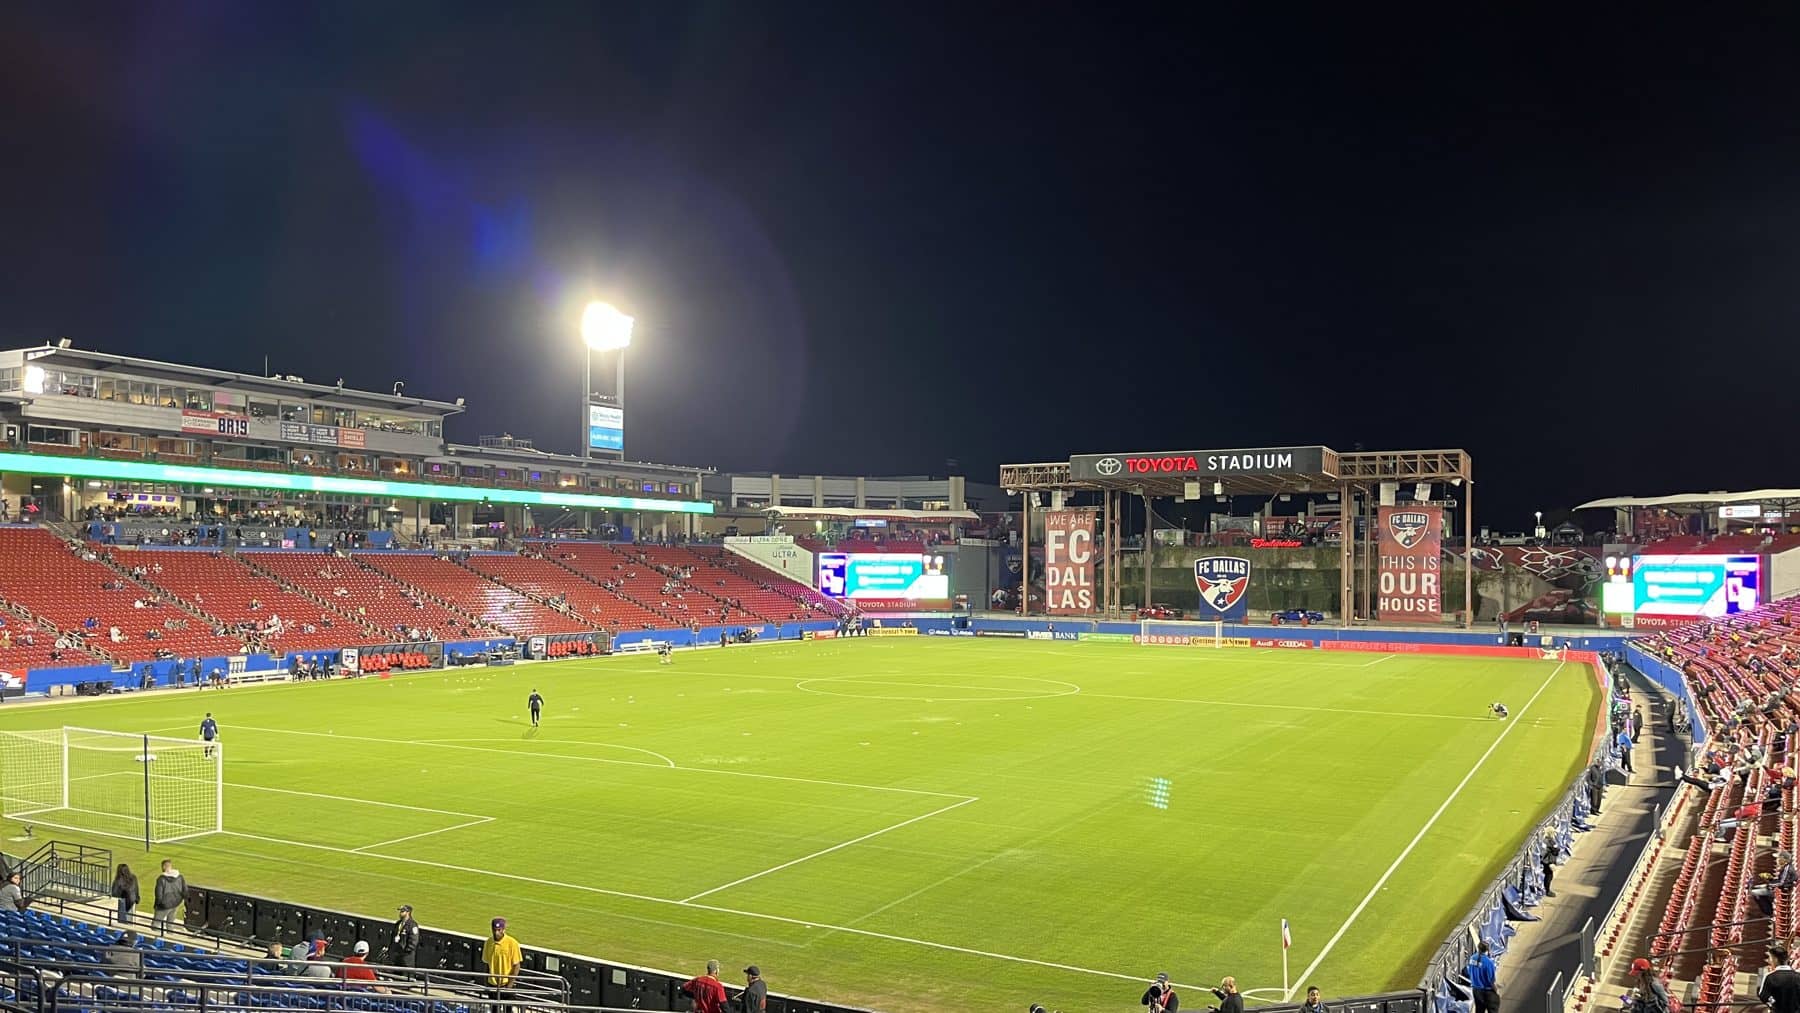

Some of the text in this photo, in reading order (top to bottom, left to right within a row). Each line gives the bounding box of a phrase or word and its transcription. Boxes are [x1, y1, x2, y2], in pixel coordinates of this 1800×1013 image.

[1126, 454, 1292, 473] TOYOTA STADIUM
[1050, 514, 1092, 526] WE ARE
[1392, 514, 1426, 524] FC DALLAS
[1048, 529, 1091, 564] FC
[1199, 560, 1246, 574] FC DALLAS
[1380, 556, 1437, 570] THIS IS
[1048, 567, 1091, 587] DAL
[1380, 572, 1437, 595] OUR
[887, 601, 917, 609] STADIUM
[1048, 589, 1091, 609] LAS
[1380, 598, 1437, 612] HOUSE
[1636, 617, 1667, 626] TOYOTA
[1055, 631, 1077, 640] BANK
